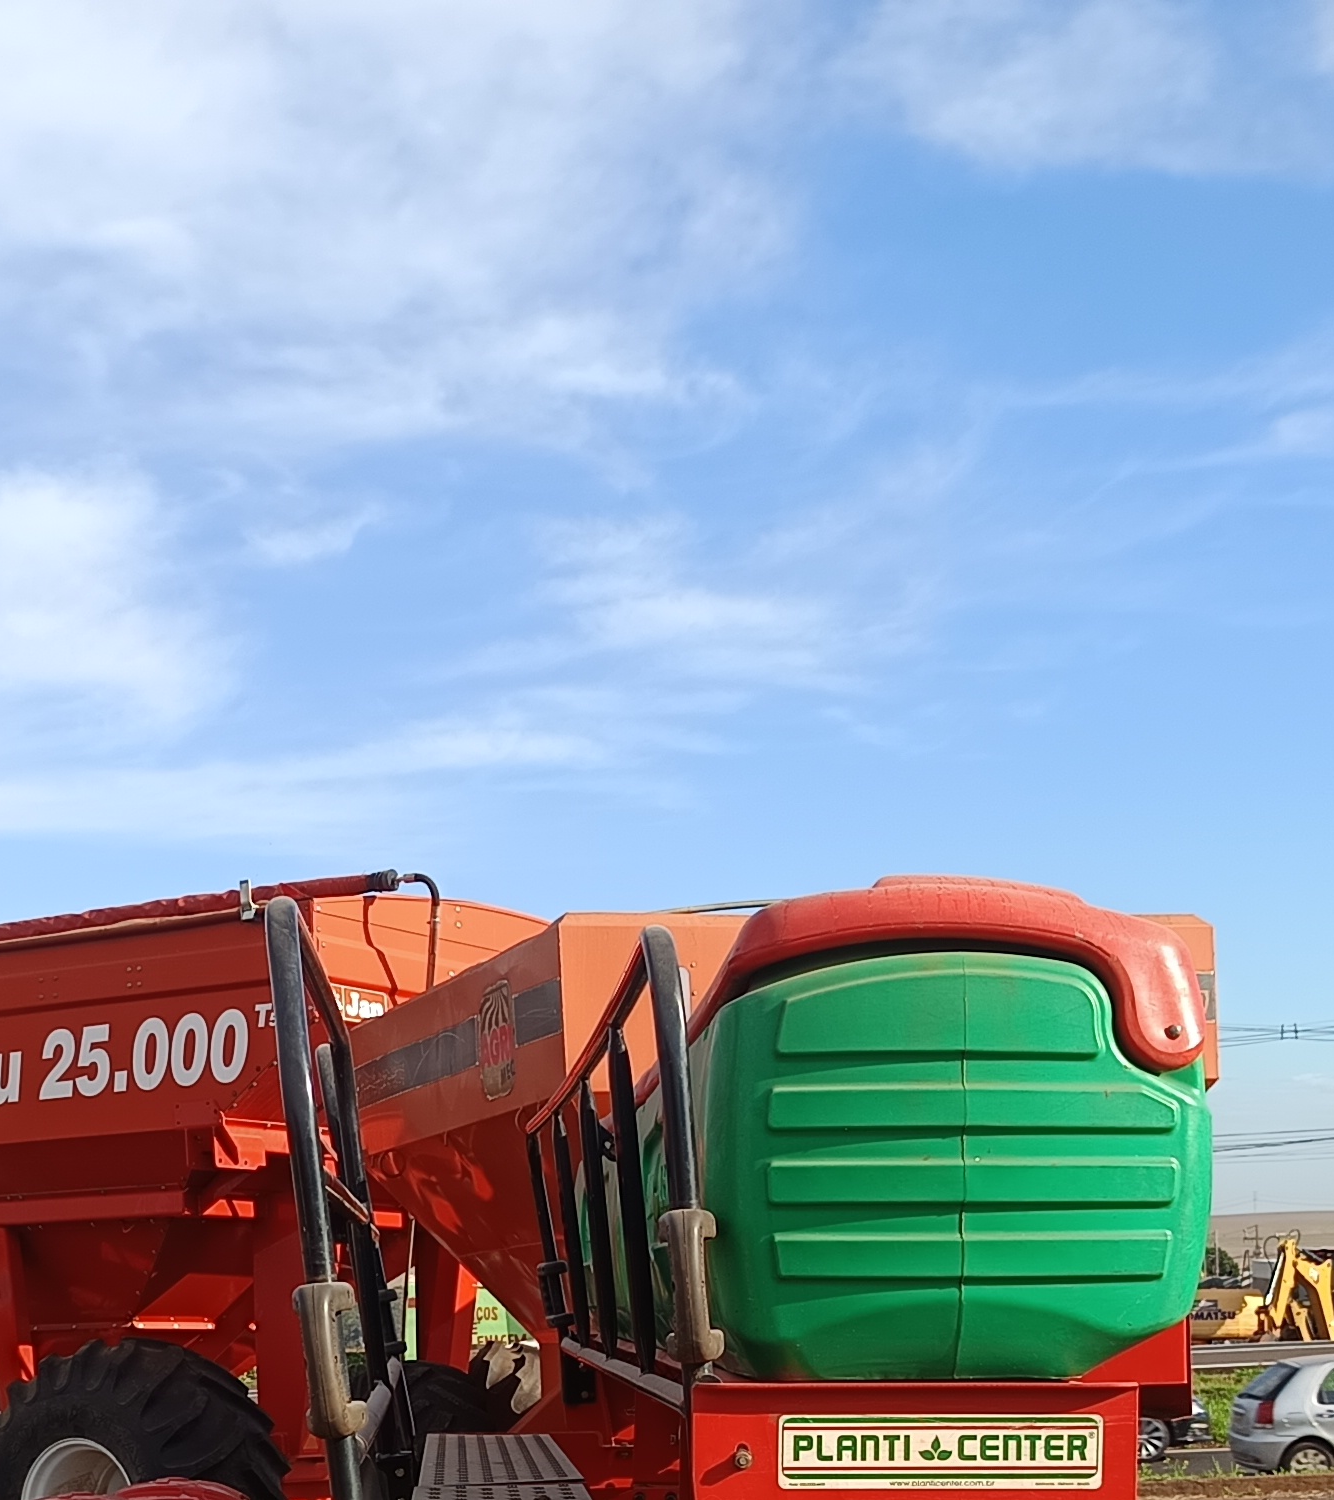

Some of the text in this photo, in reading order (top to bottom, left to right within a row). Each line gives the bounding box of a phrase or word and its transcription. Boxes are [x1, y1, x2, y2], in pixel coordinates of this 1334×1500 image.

[346, 991, 384, 1018] Jan
[38, 1008, 249, 1101] 25.000
[1190, 1311, 1235, 1320] MATSU
[793, 1434, 1088, 1462] PLANTI CENTER
